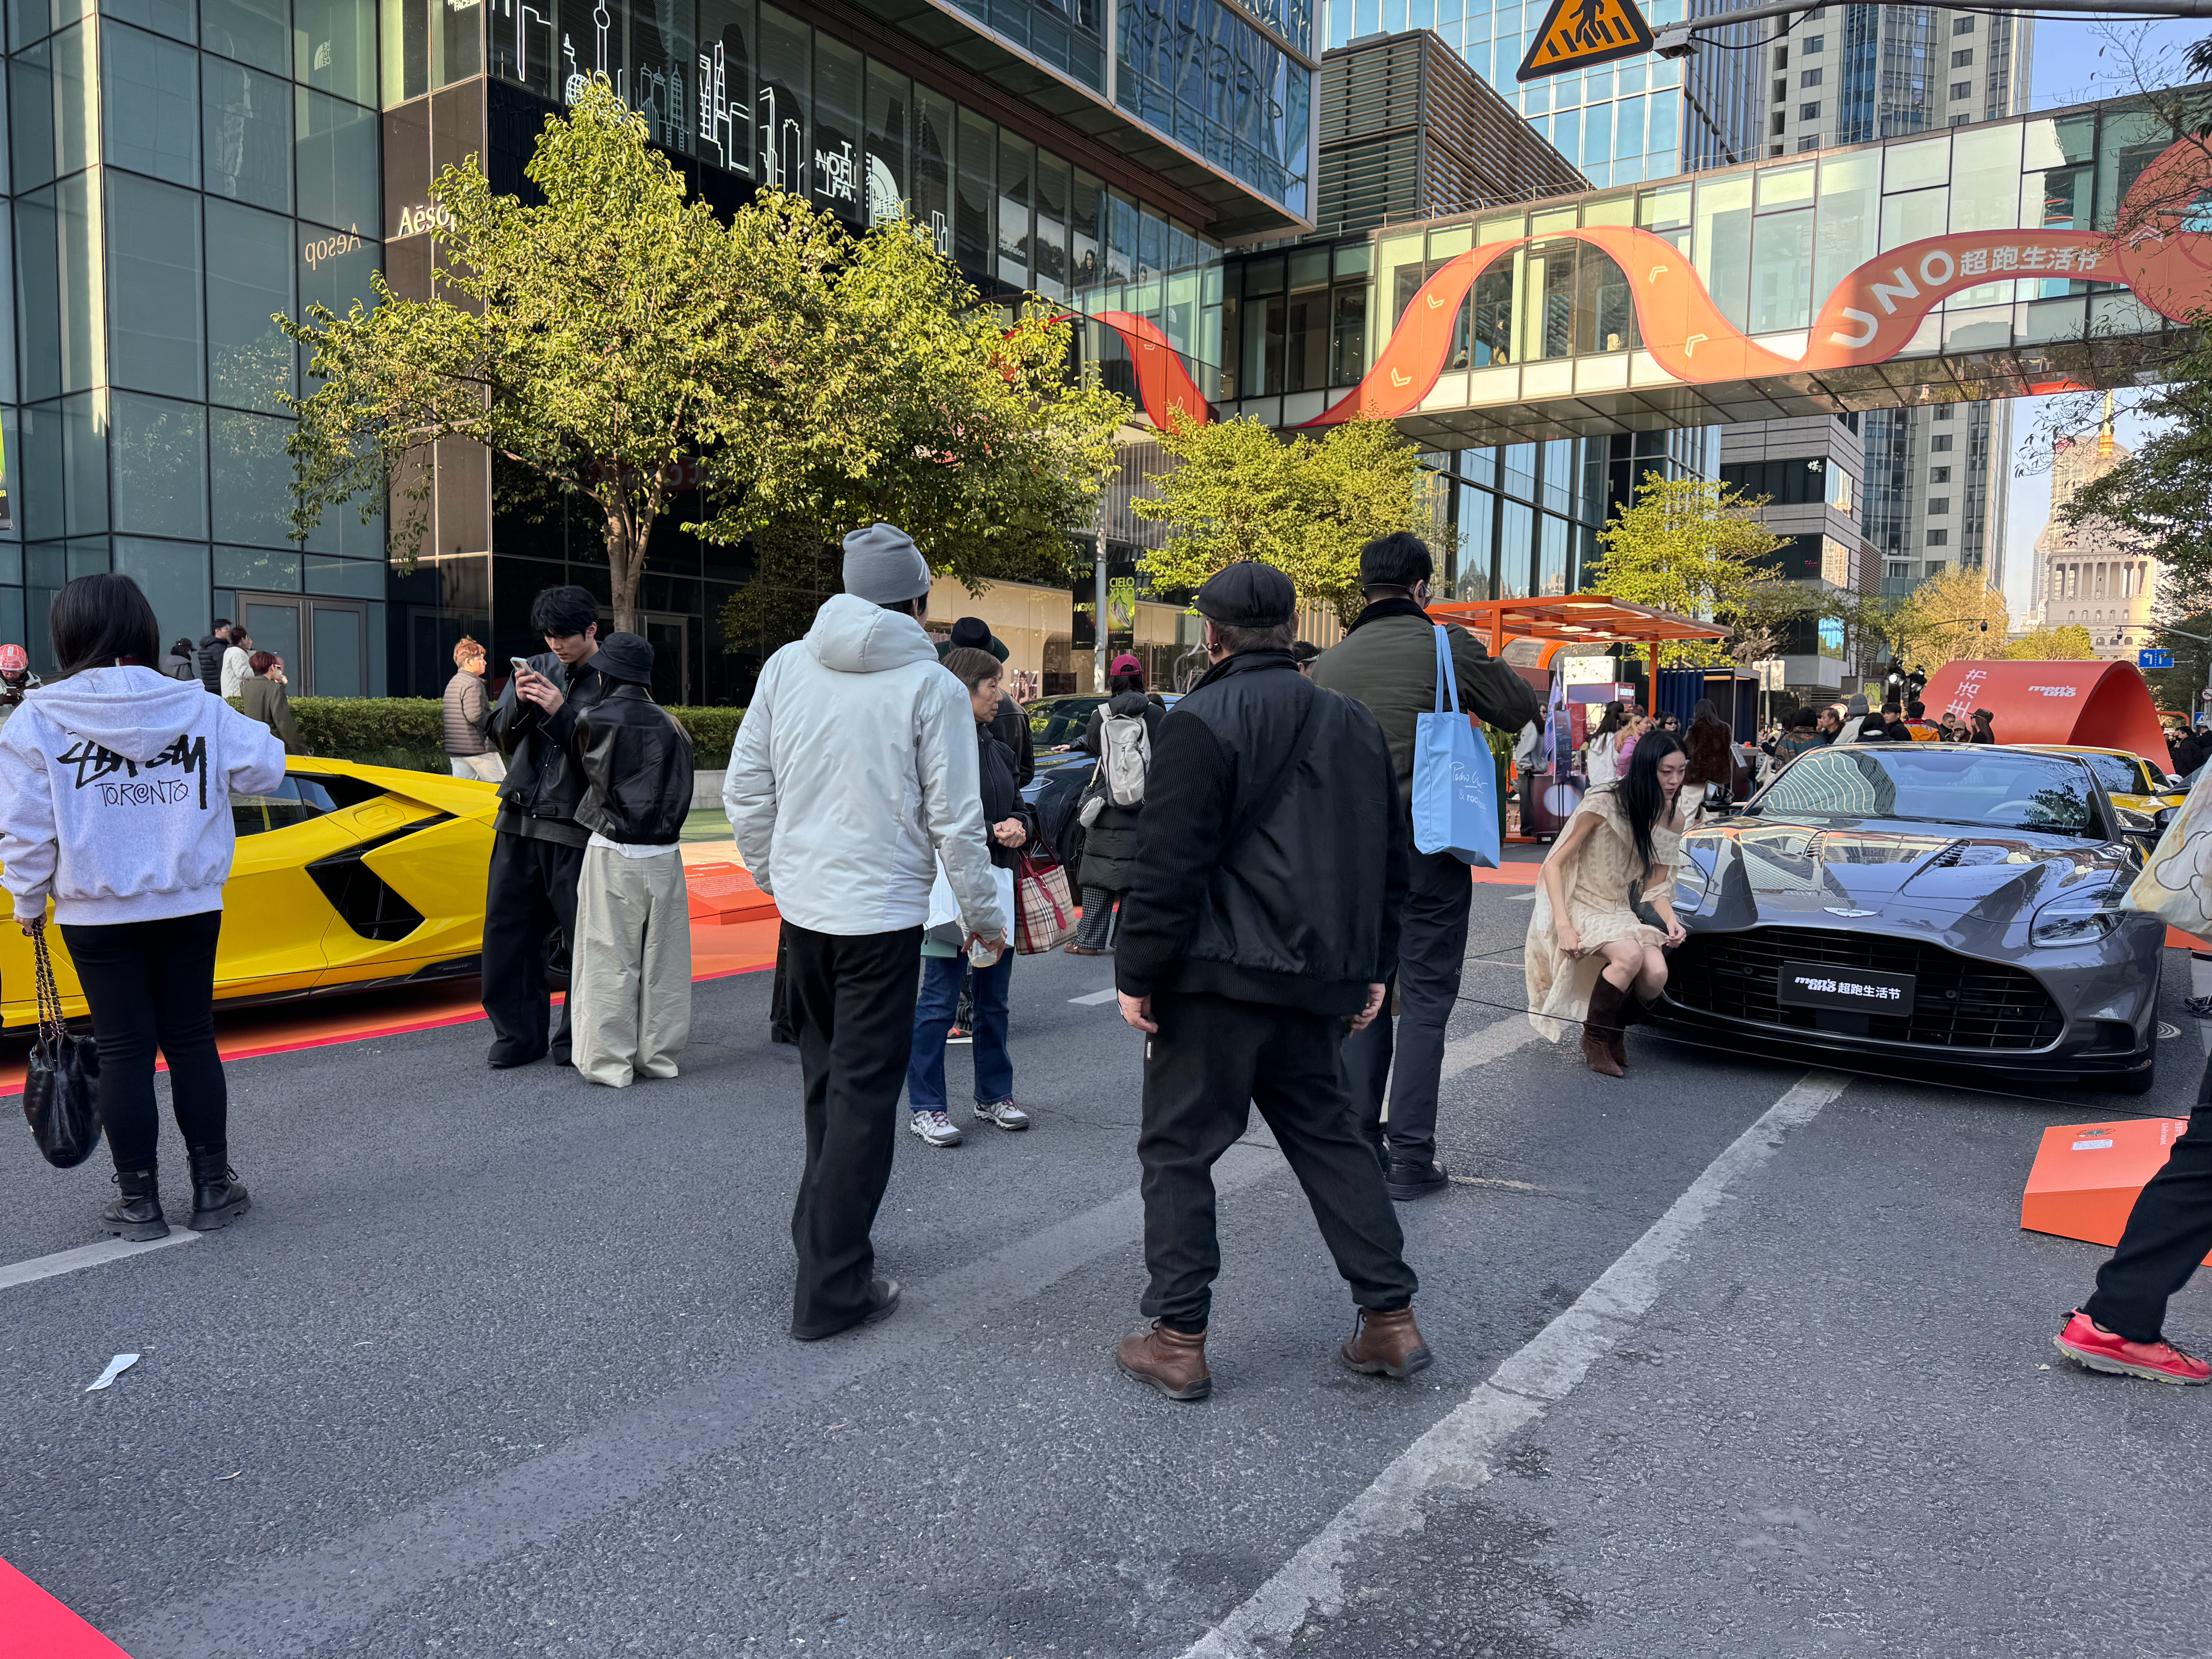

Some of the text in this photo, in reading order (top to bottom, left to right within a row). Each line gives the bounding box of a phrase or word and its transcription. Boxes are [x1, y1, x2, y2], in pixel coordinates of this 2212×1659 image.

[1960, 246, 2100, 277] 超跑生活节
[1830, 251, 1954, 348] UNO
[1109, 577, 1135, 588] CIELO
[1074, 602, 1096, 612] HOKA
[1795, 976, 1837, 986] men's
[1808, 984, 1836, 992] uno
[1838, 982, 1901, 1000] 超跑生活节
